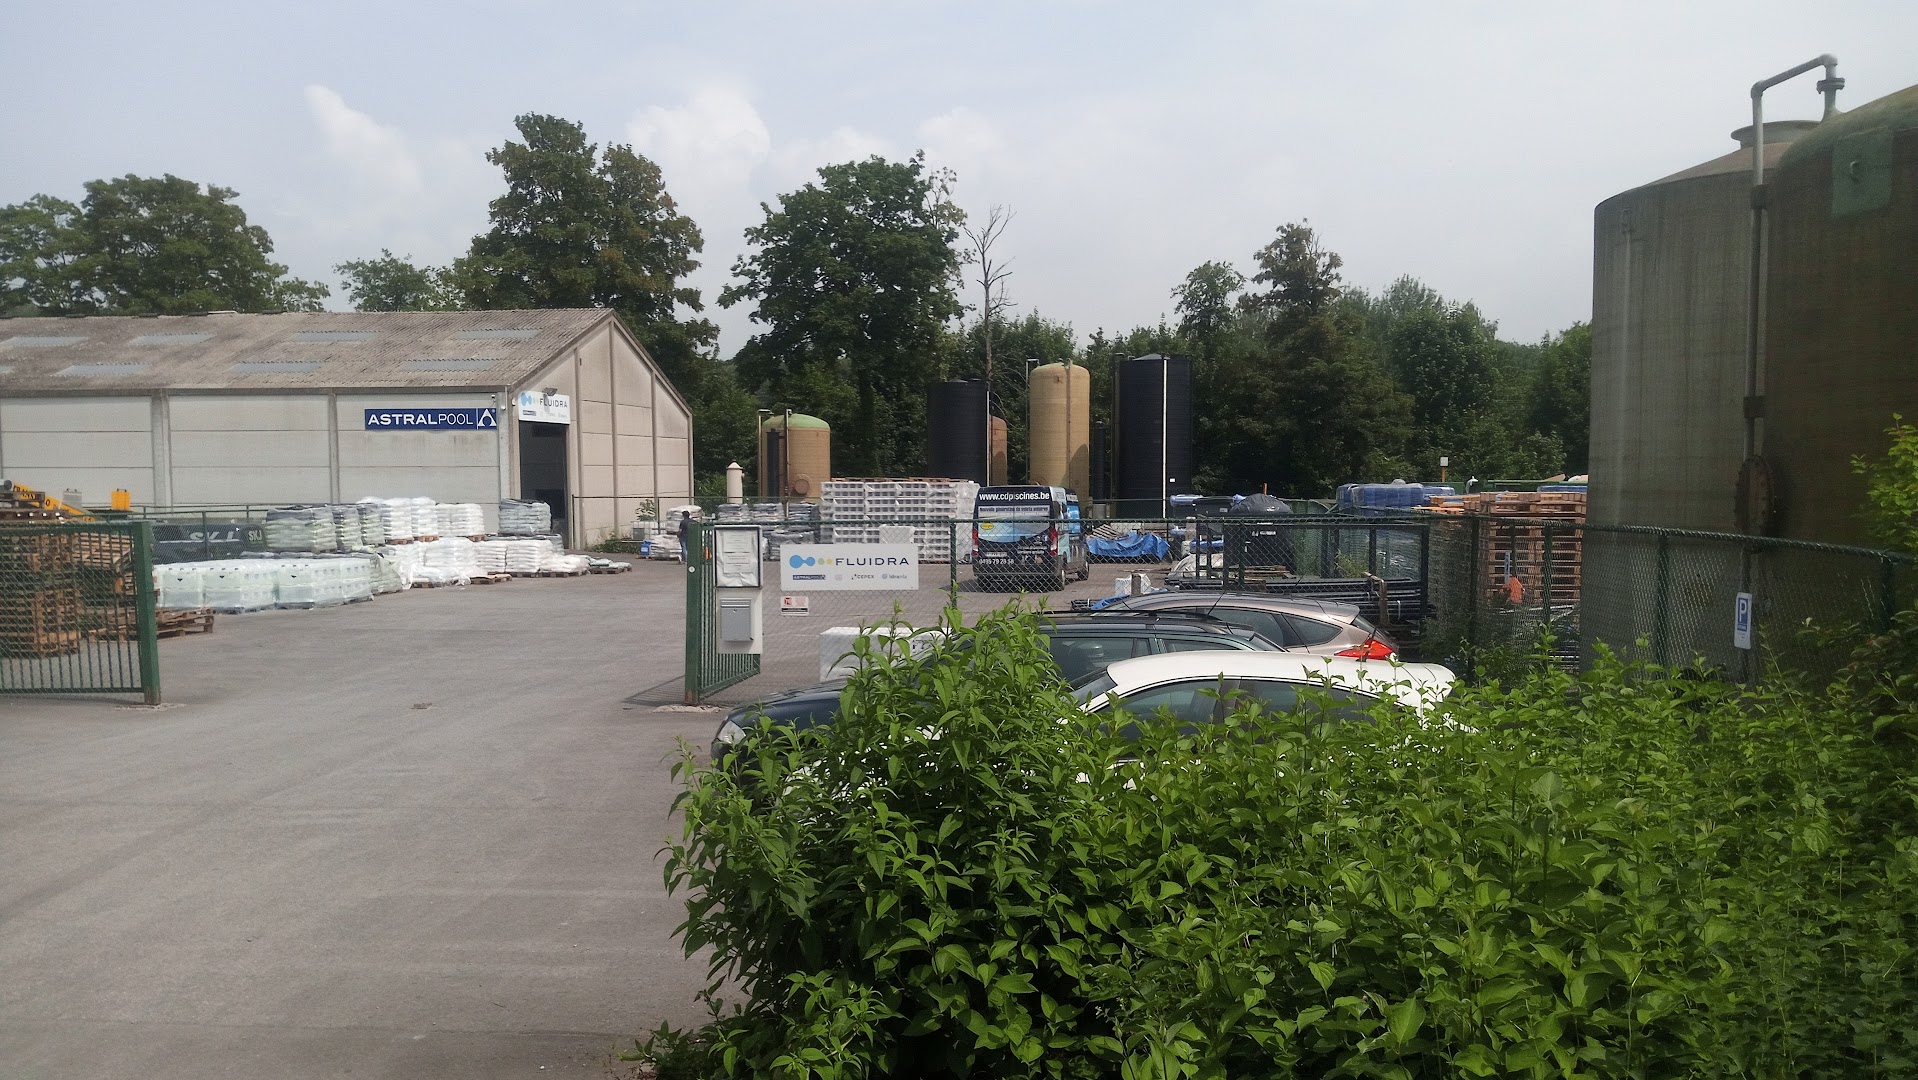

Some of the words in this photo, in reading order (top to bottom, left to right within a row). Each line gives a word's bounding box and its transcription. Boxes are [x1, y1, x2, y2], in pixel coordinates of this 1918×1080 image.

[540, 397, 568, 408] FLUIDRA
[367, 413, 474, 426] ASTRALPOOL
[979, 491, 1050, 501] www.cdpiscines.be
[835, 557, 910, 566] FLUIDRA
